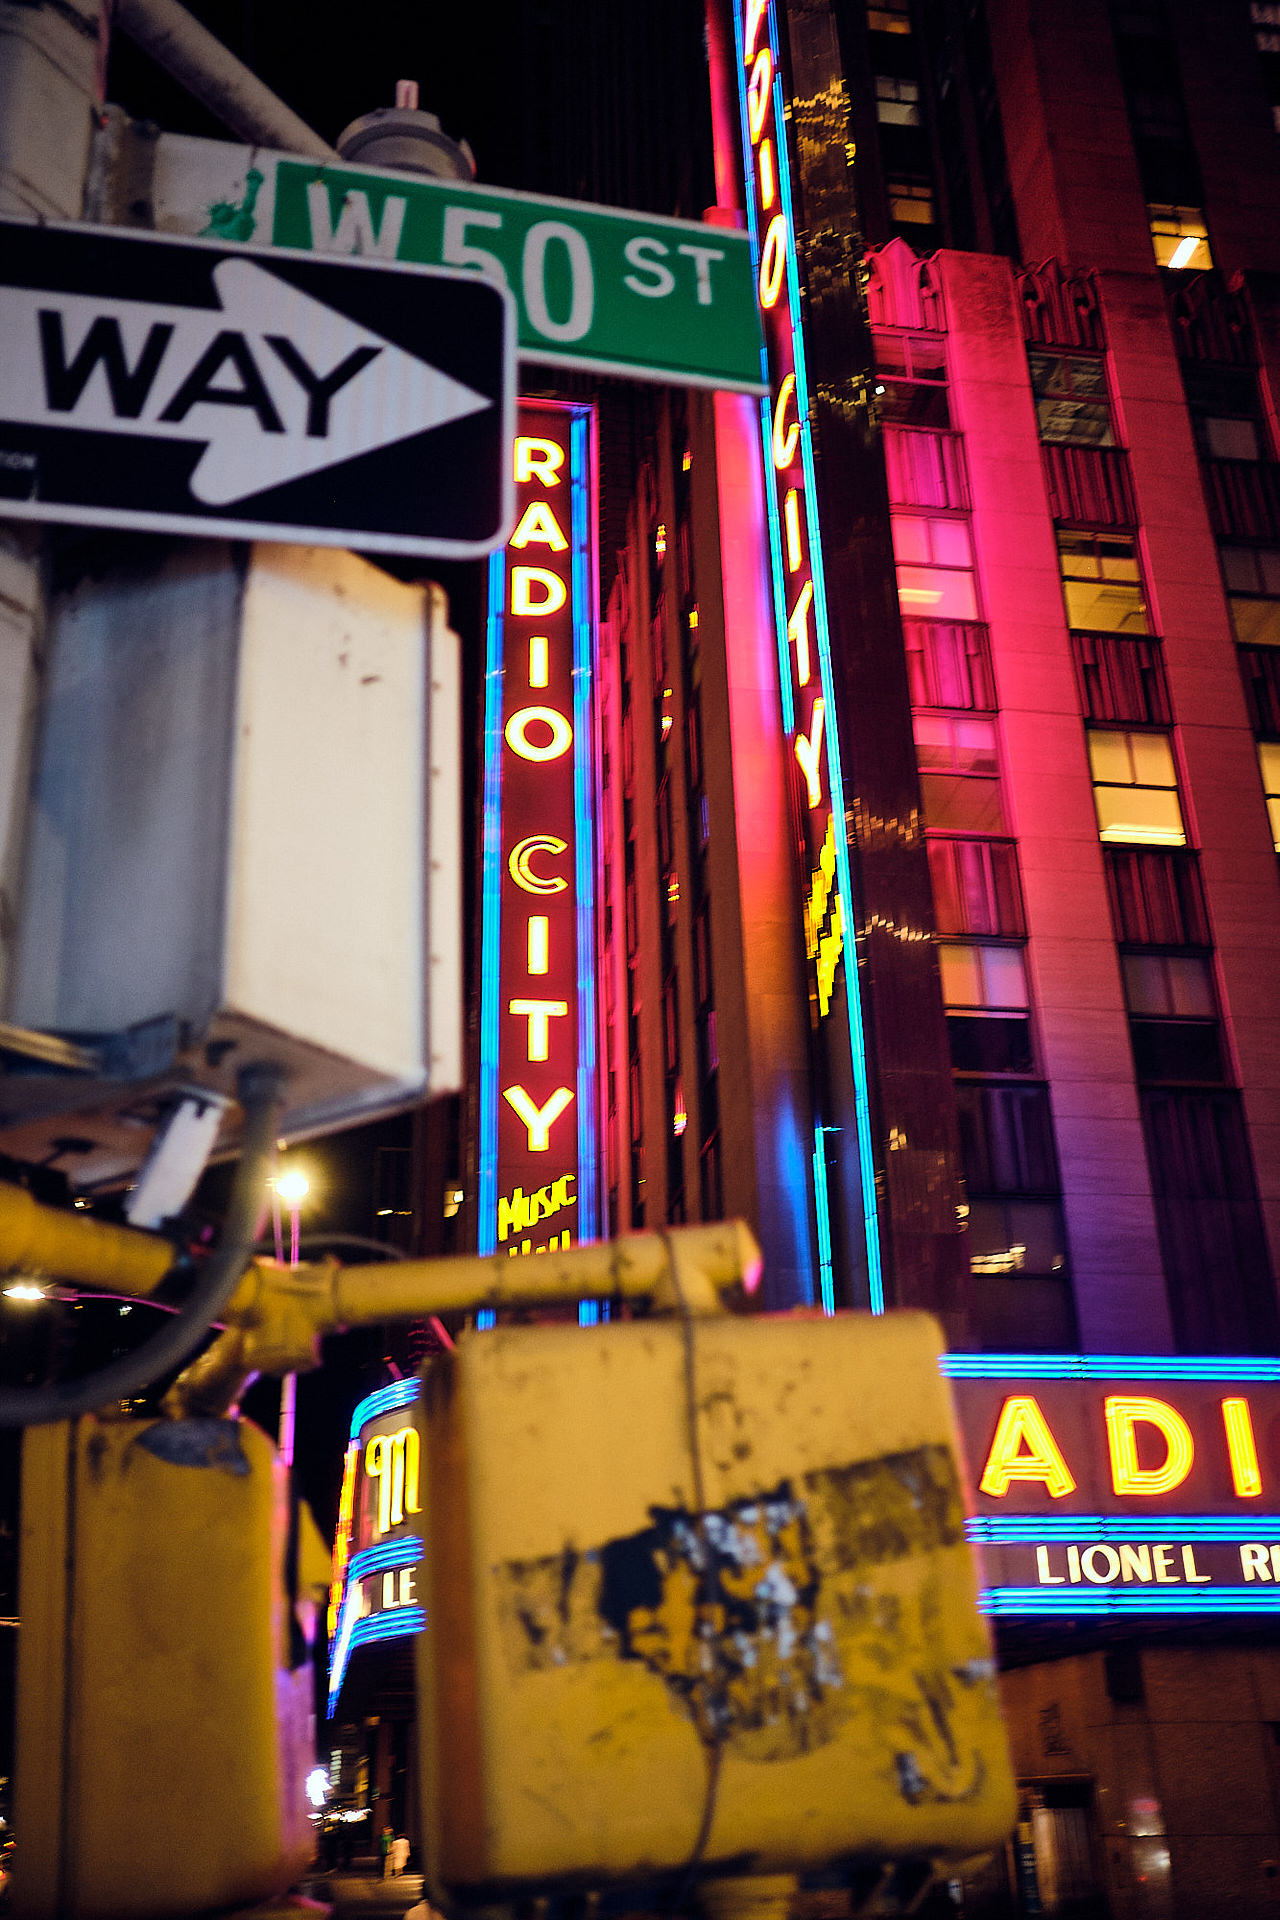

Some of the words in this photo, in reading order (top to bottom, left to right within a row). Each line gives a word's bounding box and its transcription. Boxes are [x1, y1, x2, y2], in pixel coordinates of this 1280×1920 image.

[38, 308, 384, 438] WAY
[307, 183, 406, 261] W
[441, 206, 595, 342] 50
[624, 236, 725, 305] ST
[504, 436, 574, 763] RADIO
[772, 372, 826, 810] CITY
[502, 834, 575, 1152] CITY
[1036, 1544, 1212, 1584] LIONEL
